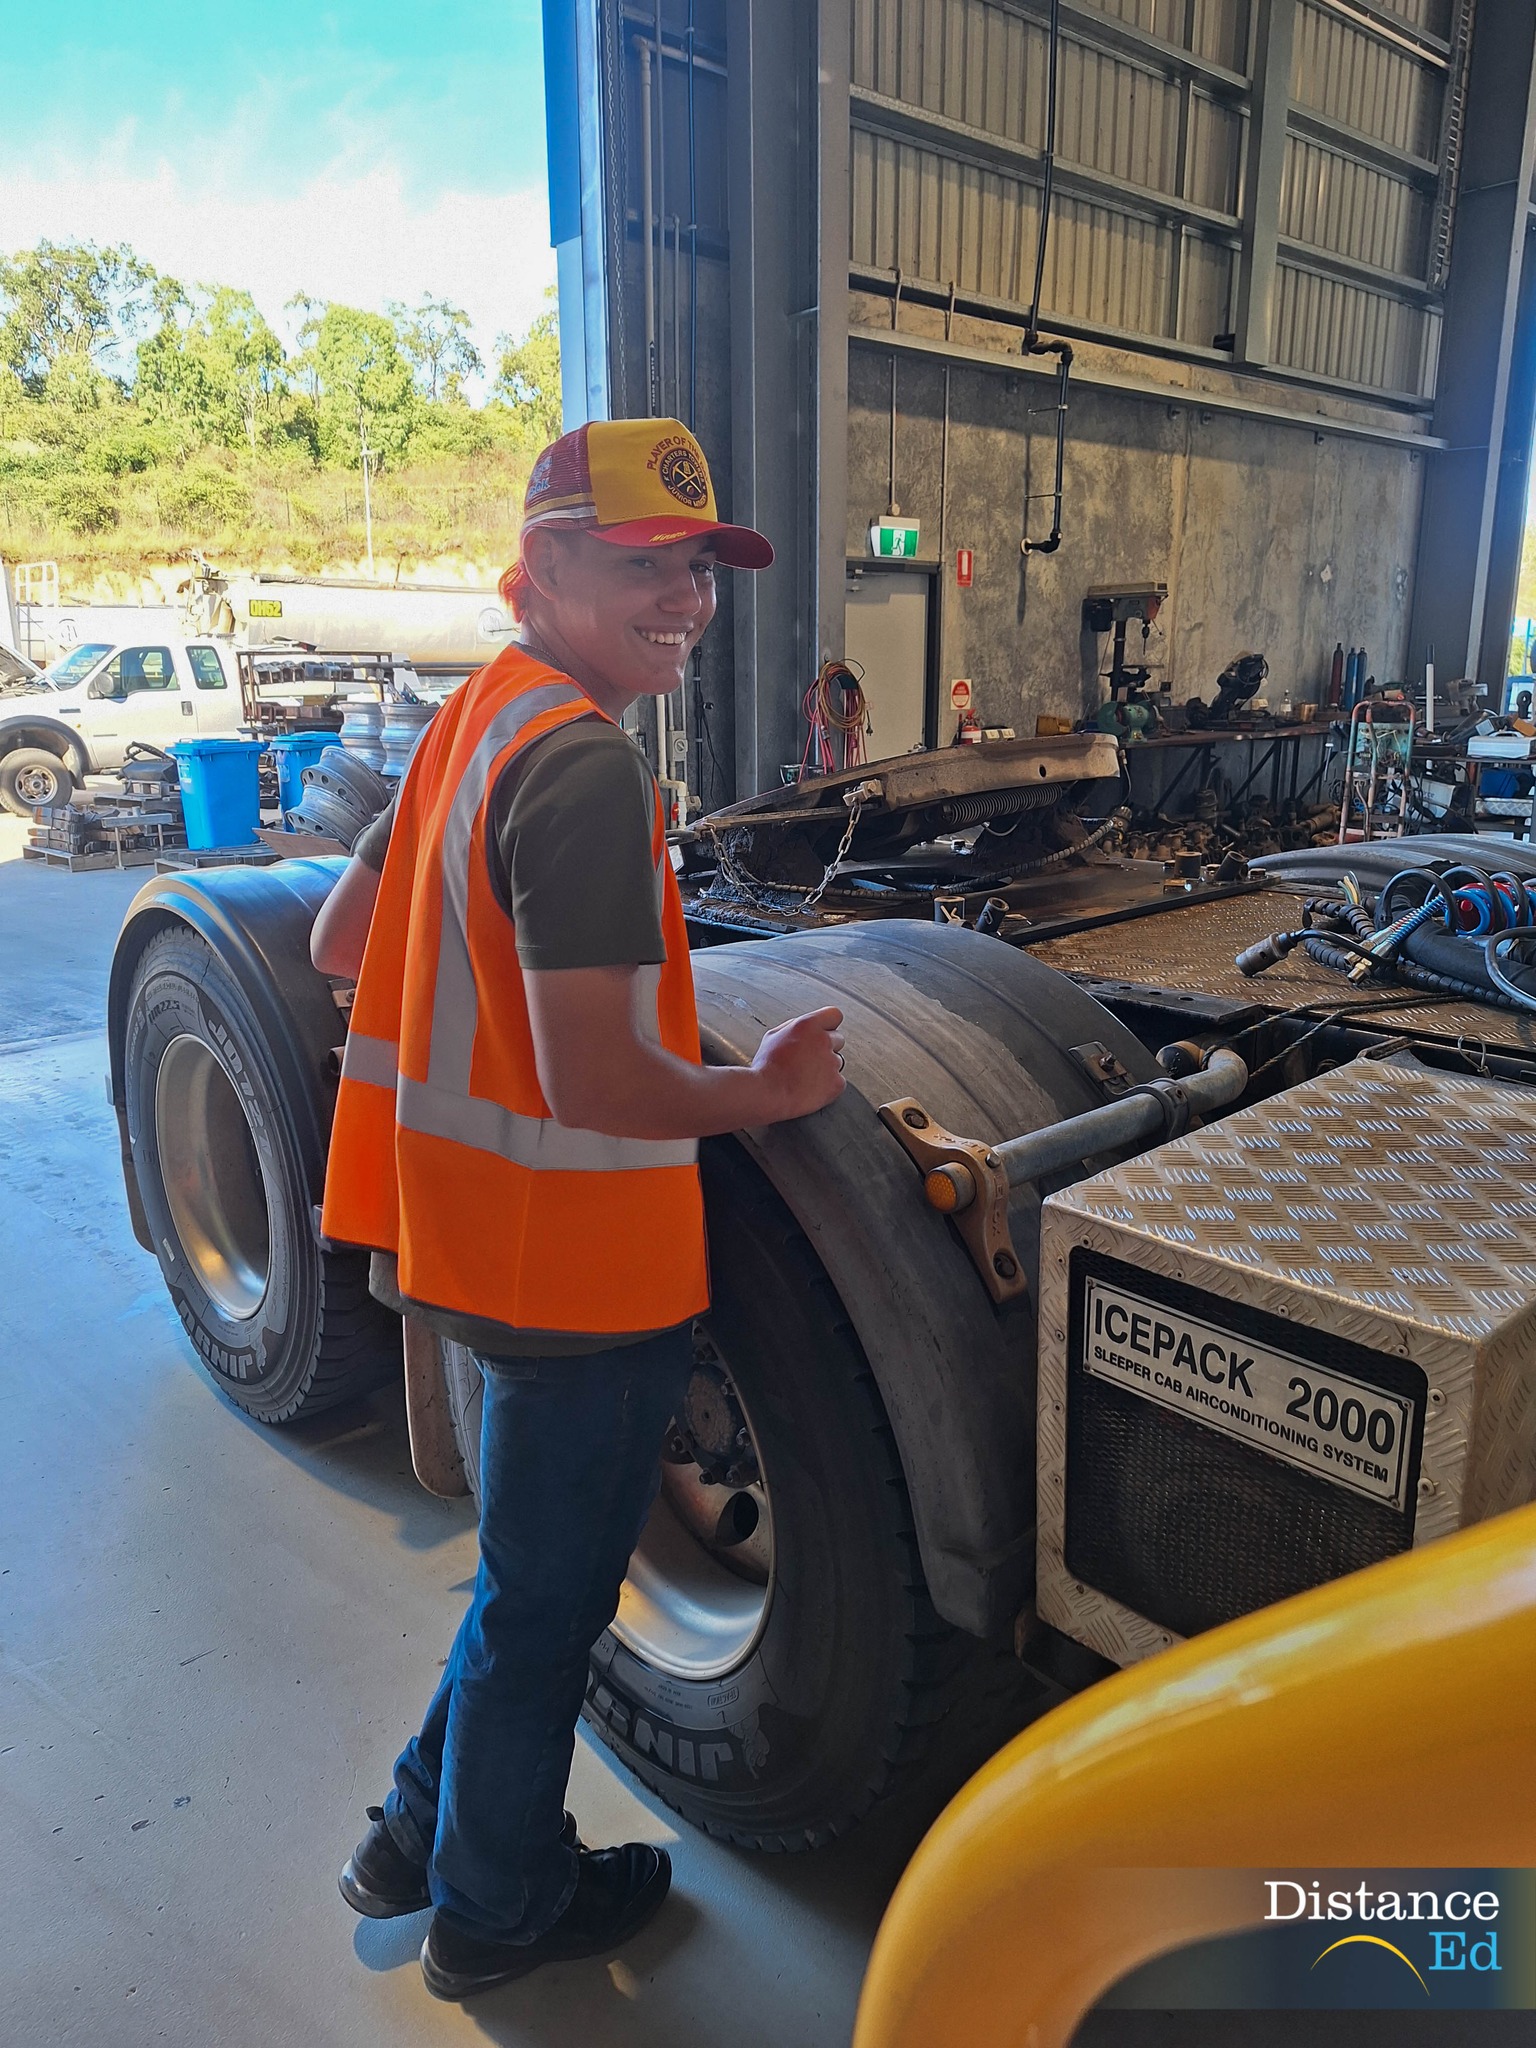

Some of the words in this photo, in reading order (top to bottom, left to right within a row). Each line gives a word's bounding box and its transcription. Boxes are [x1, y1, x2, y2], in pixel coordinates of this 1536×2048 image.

[647, 437, 673, 471] PLAYER
[673, 435, 686, 446] OF
[662, 449, 687, 475] CHARTERS
[667, 485, 693, 506] JUNIOR
[177, 1299, 253, 1379] JINYU
[1094, 1297, 1255, 1399] ICEPACK
[1285, 1376, 1396, 1455] 2000
[1094, 1345, 1151, 1381] SLEEPER
[1154, 1372, 1183, 1394] CAB
[1186, 1385, 1319, 1452] AIRCONDITIONING
[1323, 1443, 1389, 1484] SYSTEM
[585, 1670, 734, 1781] JINY
